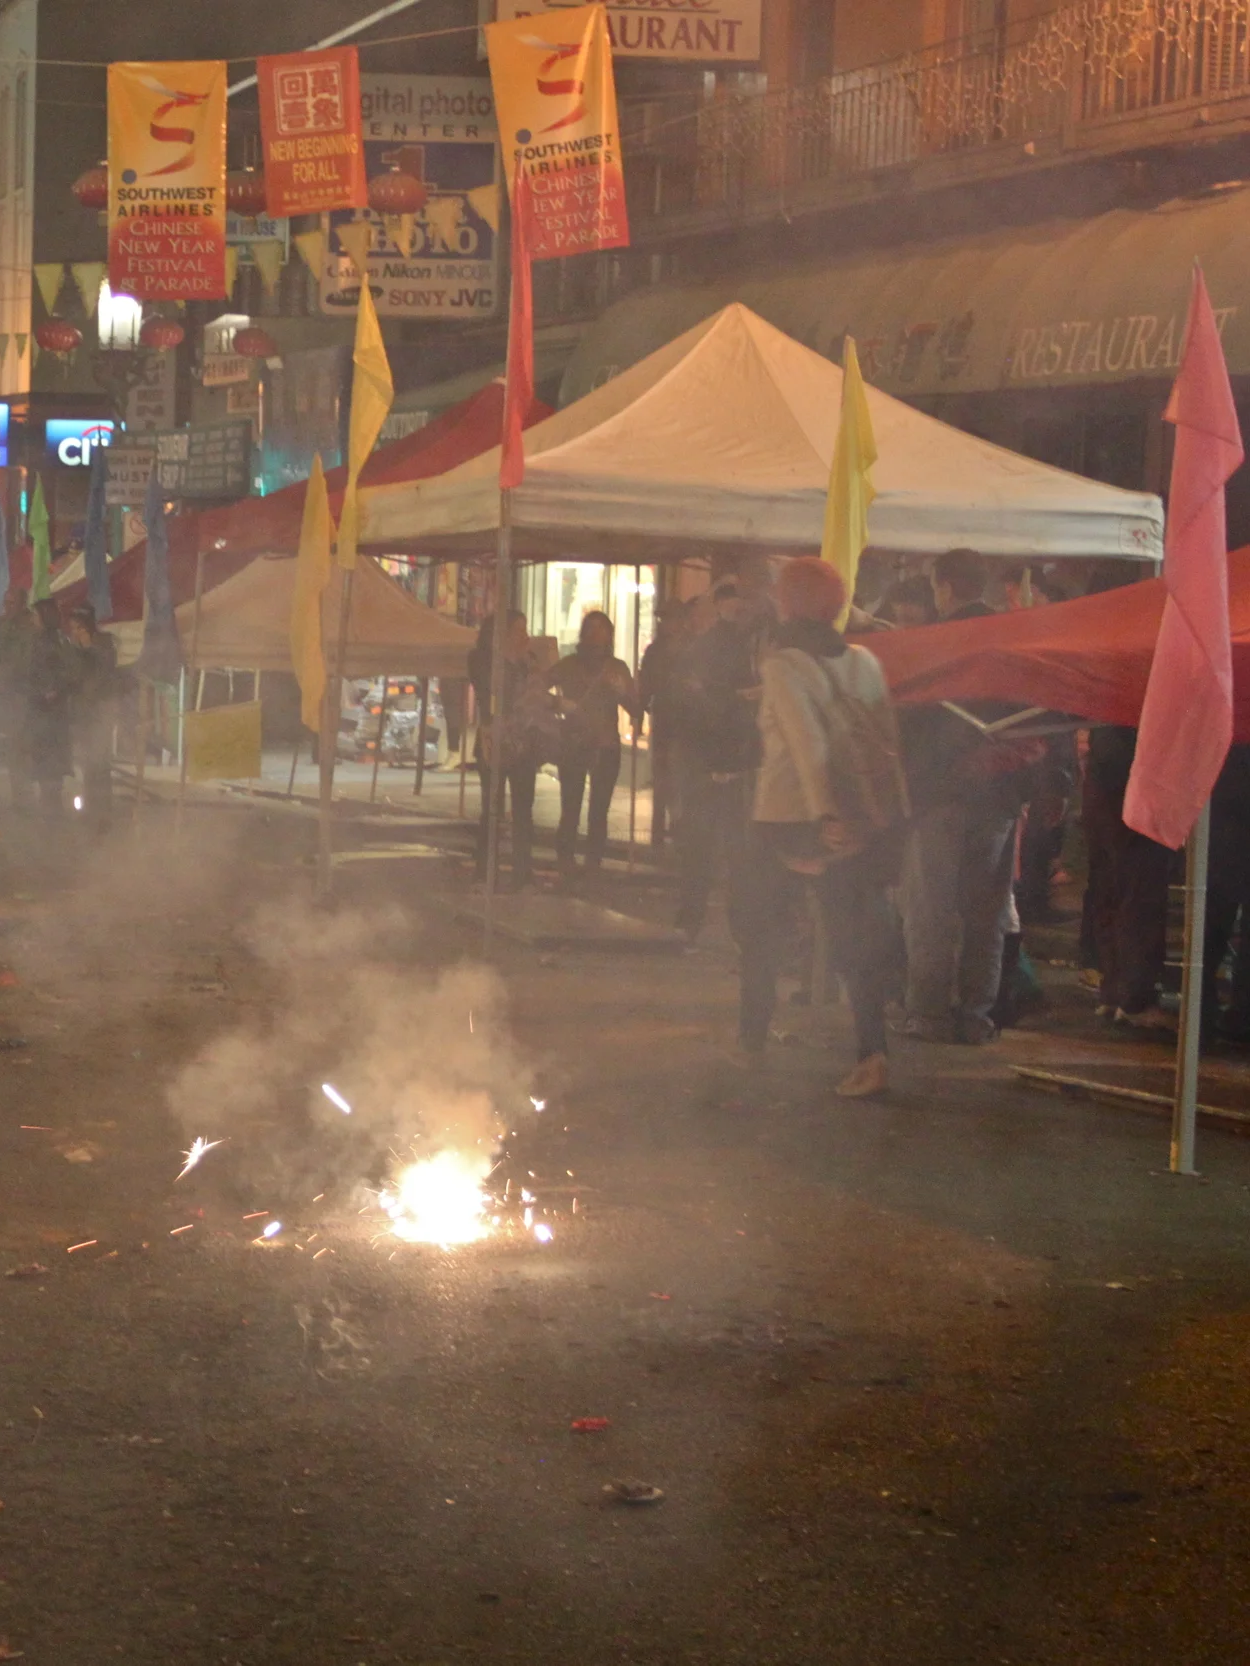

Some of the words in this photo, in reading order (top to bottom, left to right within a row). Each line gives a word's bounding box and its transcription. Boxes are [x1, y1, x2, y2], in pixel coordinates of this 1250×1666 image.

[420, 86, 493, 120] photo
[370, 121, 479, 138] ENTER
[269, 138, 296, 161] NEW
[297, 133, 358, 160] BEGINNING
[514, 134, 613, 162] SOUTHWEST
[292, 161, 318, 184] FOR
[318, 159, 340, 181] ALL
[530, 150, 613, 177] IRLINES
[117, 187, 216, 201] SOUTHWEST
[574, 186, 618, 207] YEAR
[117, 203, 214, 217] AIRLINES
[129, 219, 203, 236] CHINESE
[554, 223, 619, 249] PARADE
[118, 238, 161, 255] NEW
[168, 237, 216, 254] YEAR
[127, 256, 206, 274] FESTIVAL
[144, 275, 214, 292] PARADE
[388, 288, 448, 306] SONY
[450, 288, 492, 306] JVC
[1009, 306, 1240, 380] RESTAURAT
